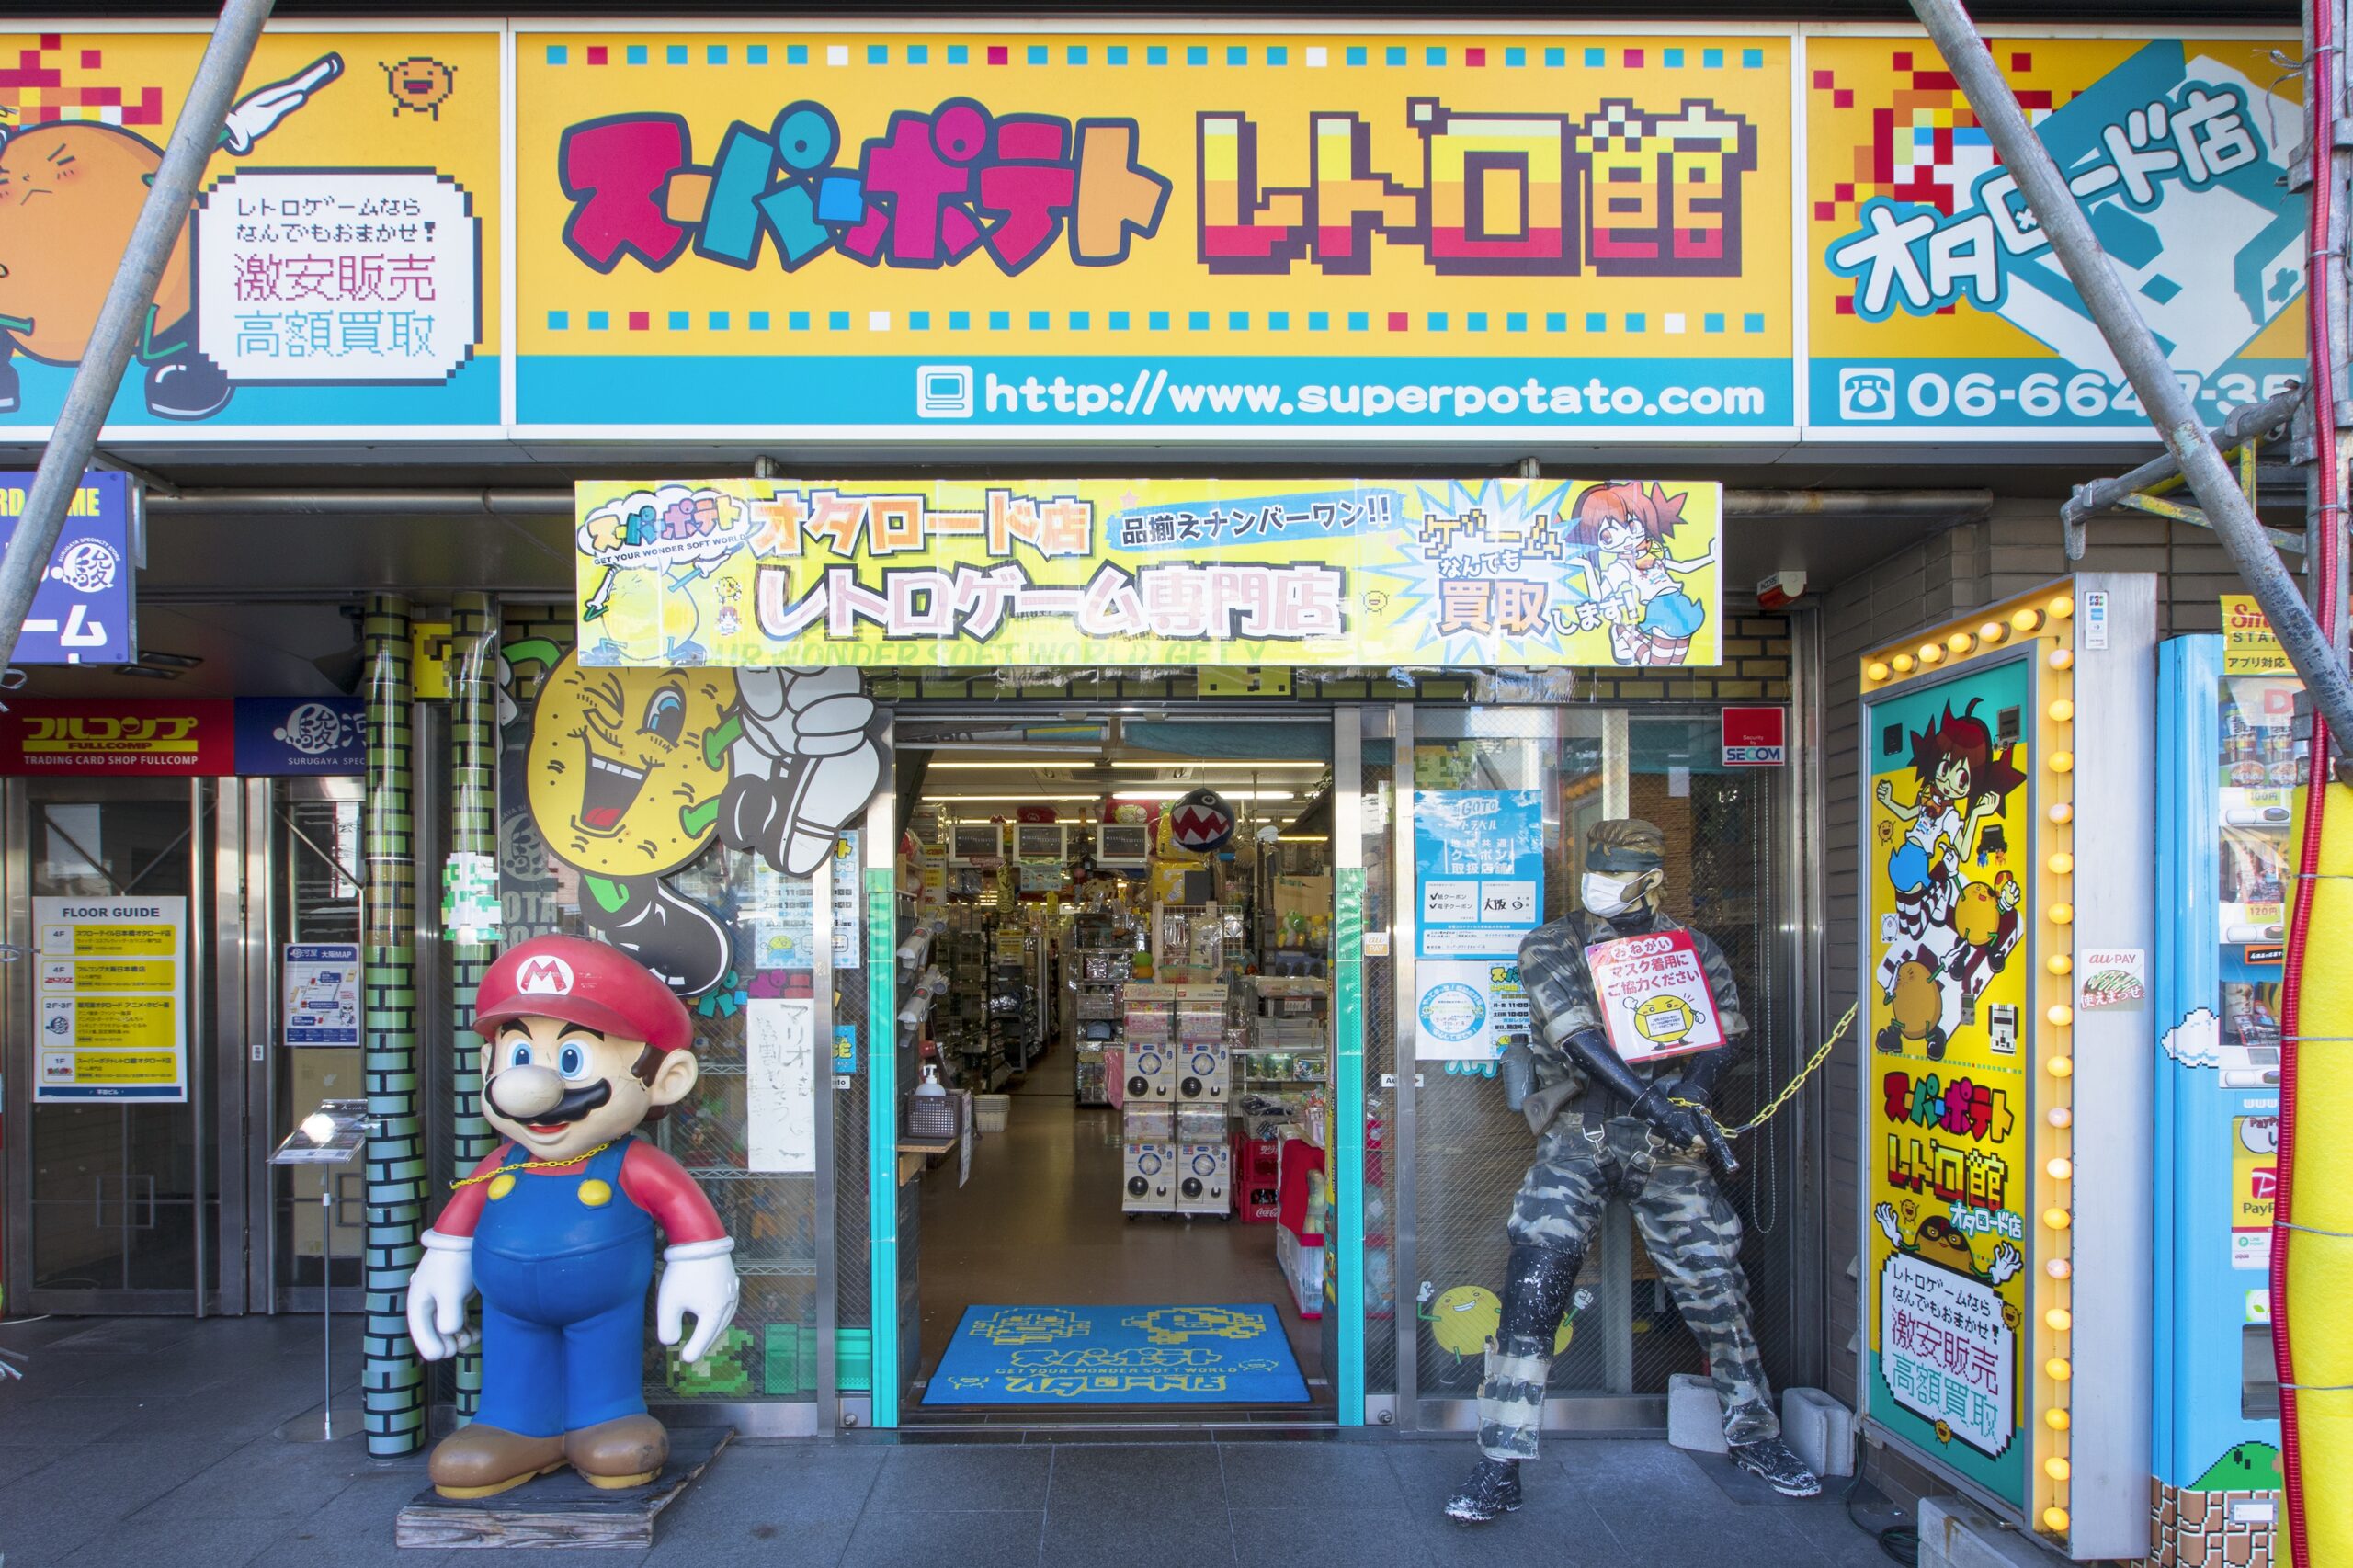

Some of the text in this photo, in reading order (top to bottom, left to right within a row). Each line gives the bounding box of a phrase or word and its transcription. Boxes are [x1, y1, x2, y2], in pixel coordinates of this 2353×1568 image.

[558, 97, 1173, 276] スーパーポテト
[1197, 97, 1757, 277] レトロ館
[236, 197, 423, 218] レトロゲームなら
[233, 253, 437, 301] 激安販売
[234, 310, 437, 358] 高額買取
[985, 369, 1765, 417] http://www.superpotato.com
[67, 488, 100, 517] ME
[587, 494, 742, 553] スーパーポテト
[752, 488, 1095, 559] オタロード店
[1418, 508, 1566, 560] ゲーム
[594, 534, 745, 565] GET YOUR WONDER SOFT WORLD
[1438, 549, 1522, 579] なんでも
[755, 559, 1347, 644] レトロゲーム専門店
[24, 756, 199, 766] TRADING CARD SHOP FULLCOMP
[67, 742, 153, 751] FULLCOMP
[288, 756, 339, 766] SURUGAYA
[1726, 747, 1781, 762] SECOM
[1450, 849, 1508, 861] クーポン
[63, 907, 161, 917] FLOOR GUIDE
[1613, 937, 1671, 959] おねがい
[2088, 953, 2136, 964] au PAY
[520, 960, 567, 993] M
[1608, 969, 1700, 997] ご協力ください
[1610, 954, 1689, 979] マスク着用に
[1884, 1071, 2015, 1143] スーパーポテト
[1888, 1132, 2009, 1216] レトロ館
[1949, 1201, 2023, 1239] オタロード店
[1893, 1263, 1992, 1317] レトロゲームなら
[1892, 1304, 1999, 1396] 激安販売
[1892, 1351, 1999, 1445] 高額買取
